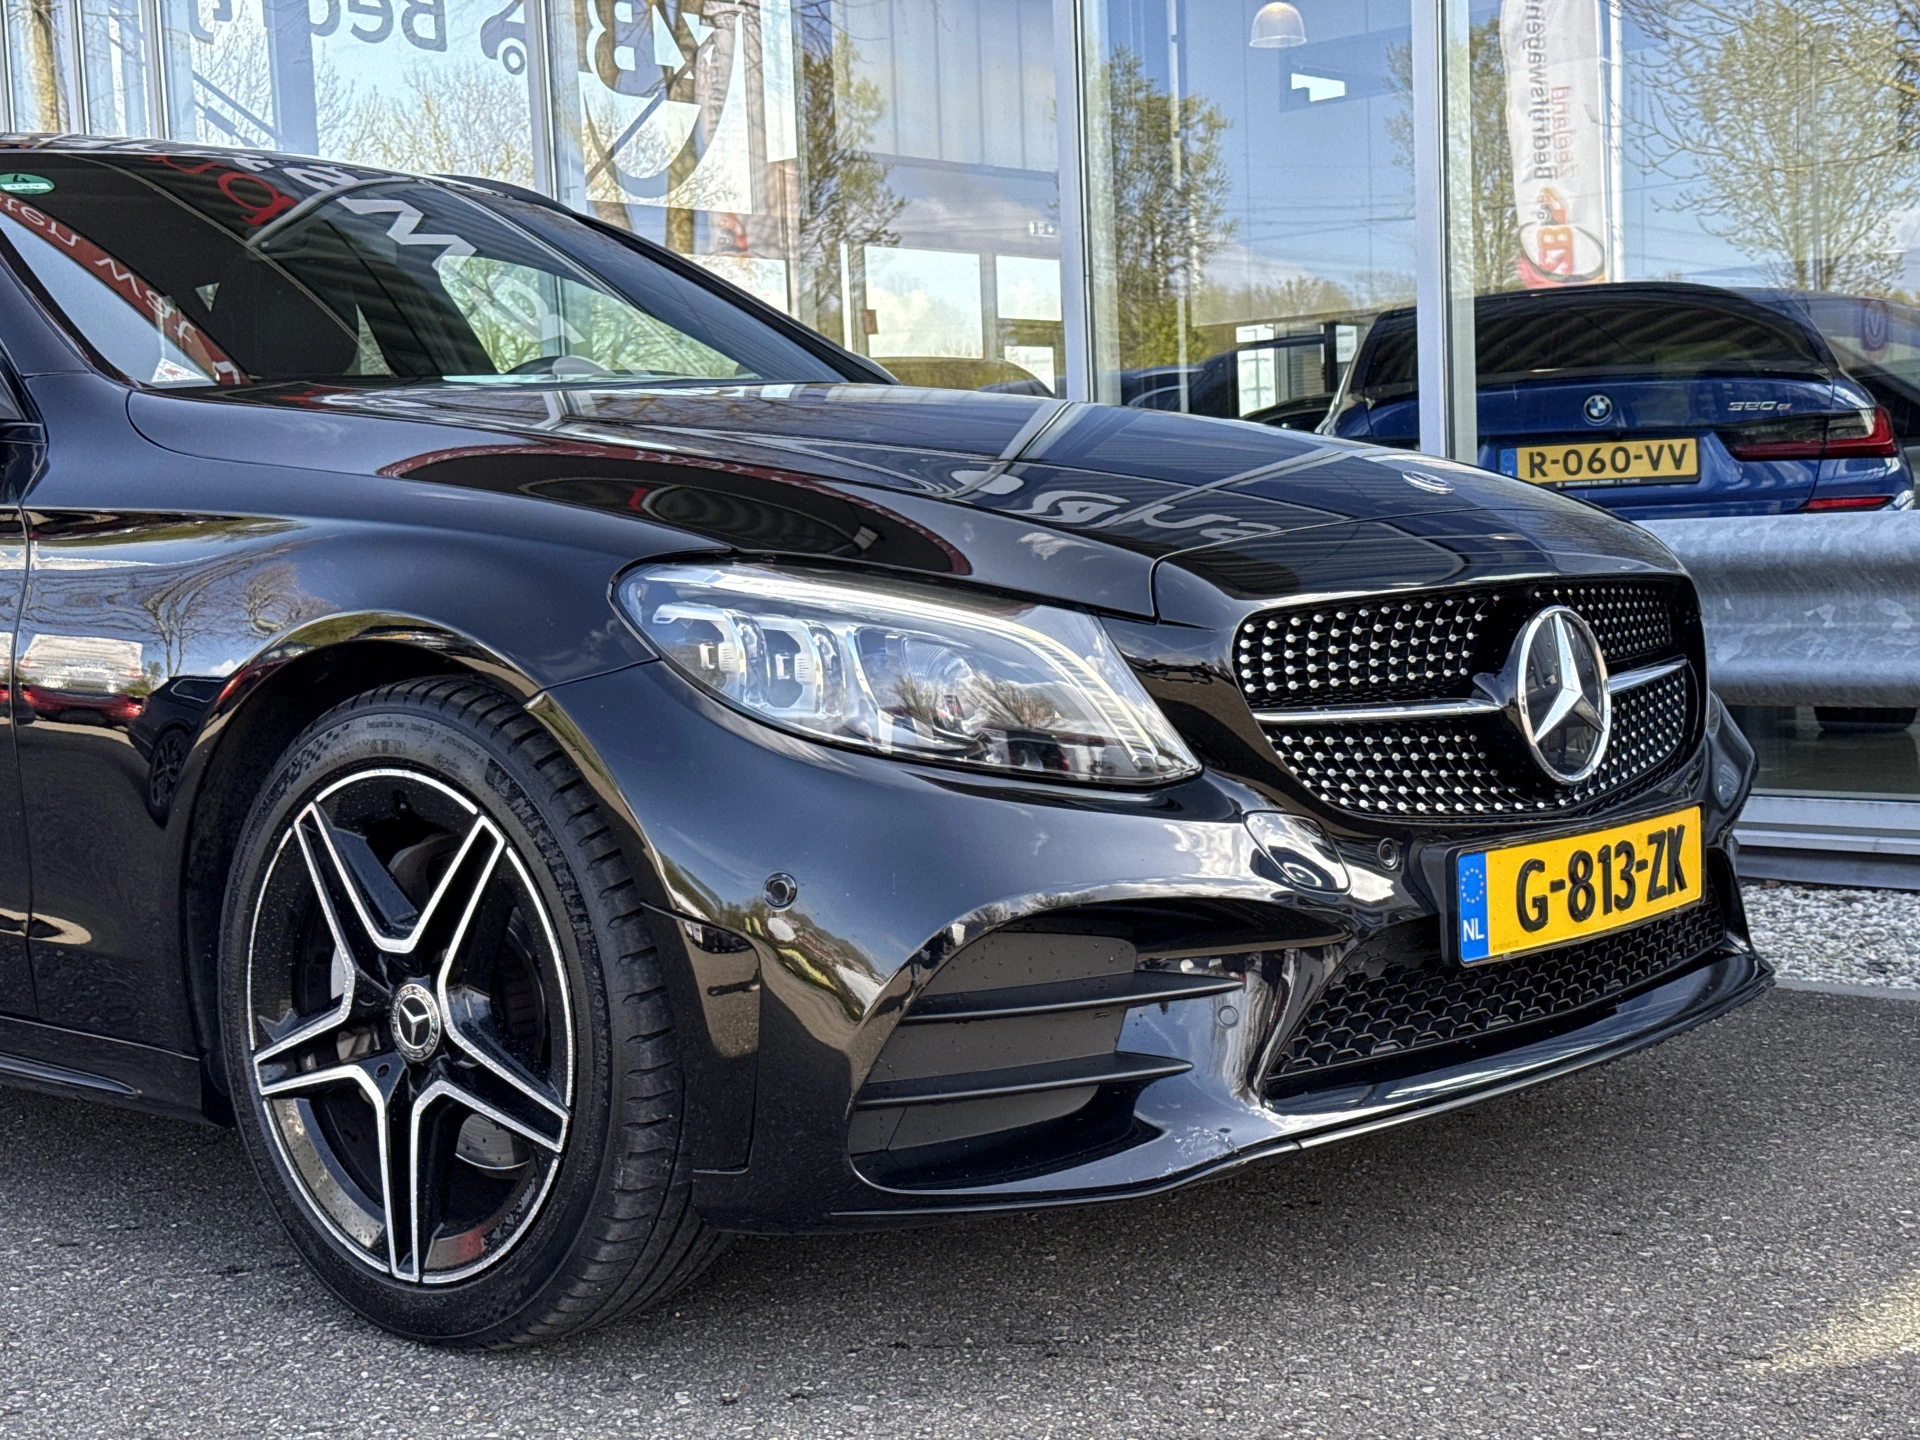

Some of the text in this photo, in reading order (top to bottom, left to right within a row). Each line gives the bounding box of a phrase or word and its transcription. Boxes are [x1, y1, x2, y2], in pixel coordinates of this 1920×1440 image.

[1529, 443, 1688, 478] R-060-VV
[511, 796, 594, 938] MICHELIN
[1516, 824, 1687, 933] G-813-ZK
[1463, 917, 1485, 942] NL
